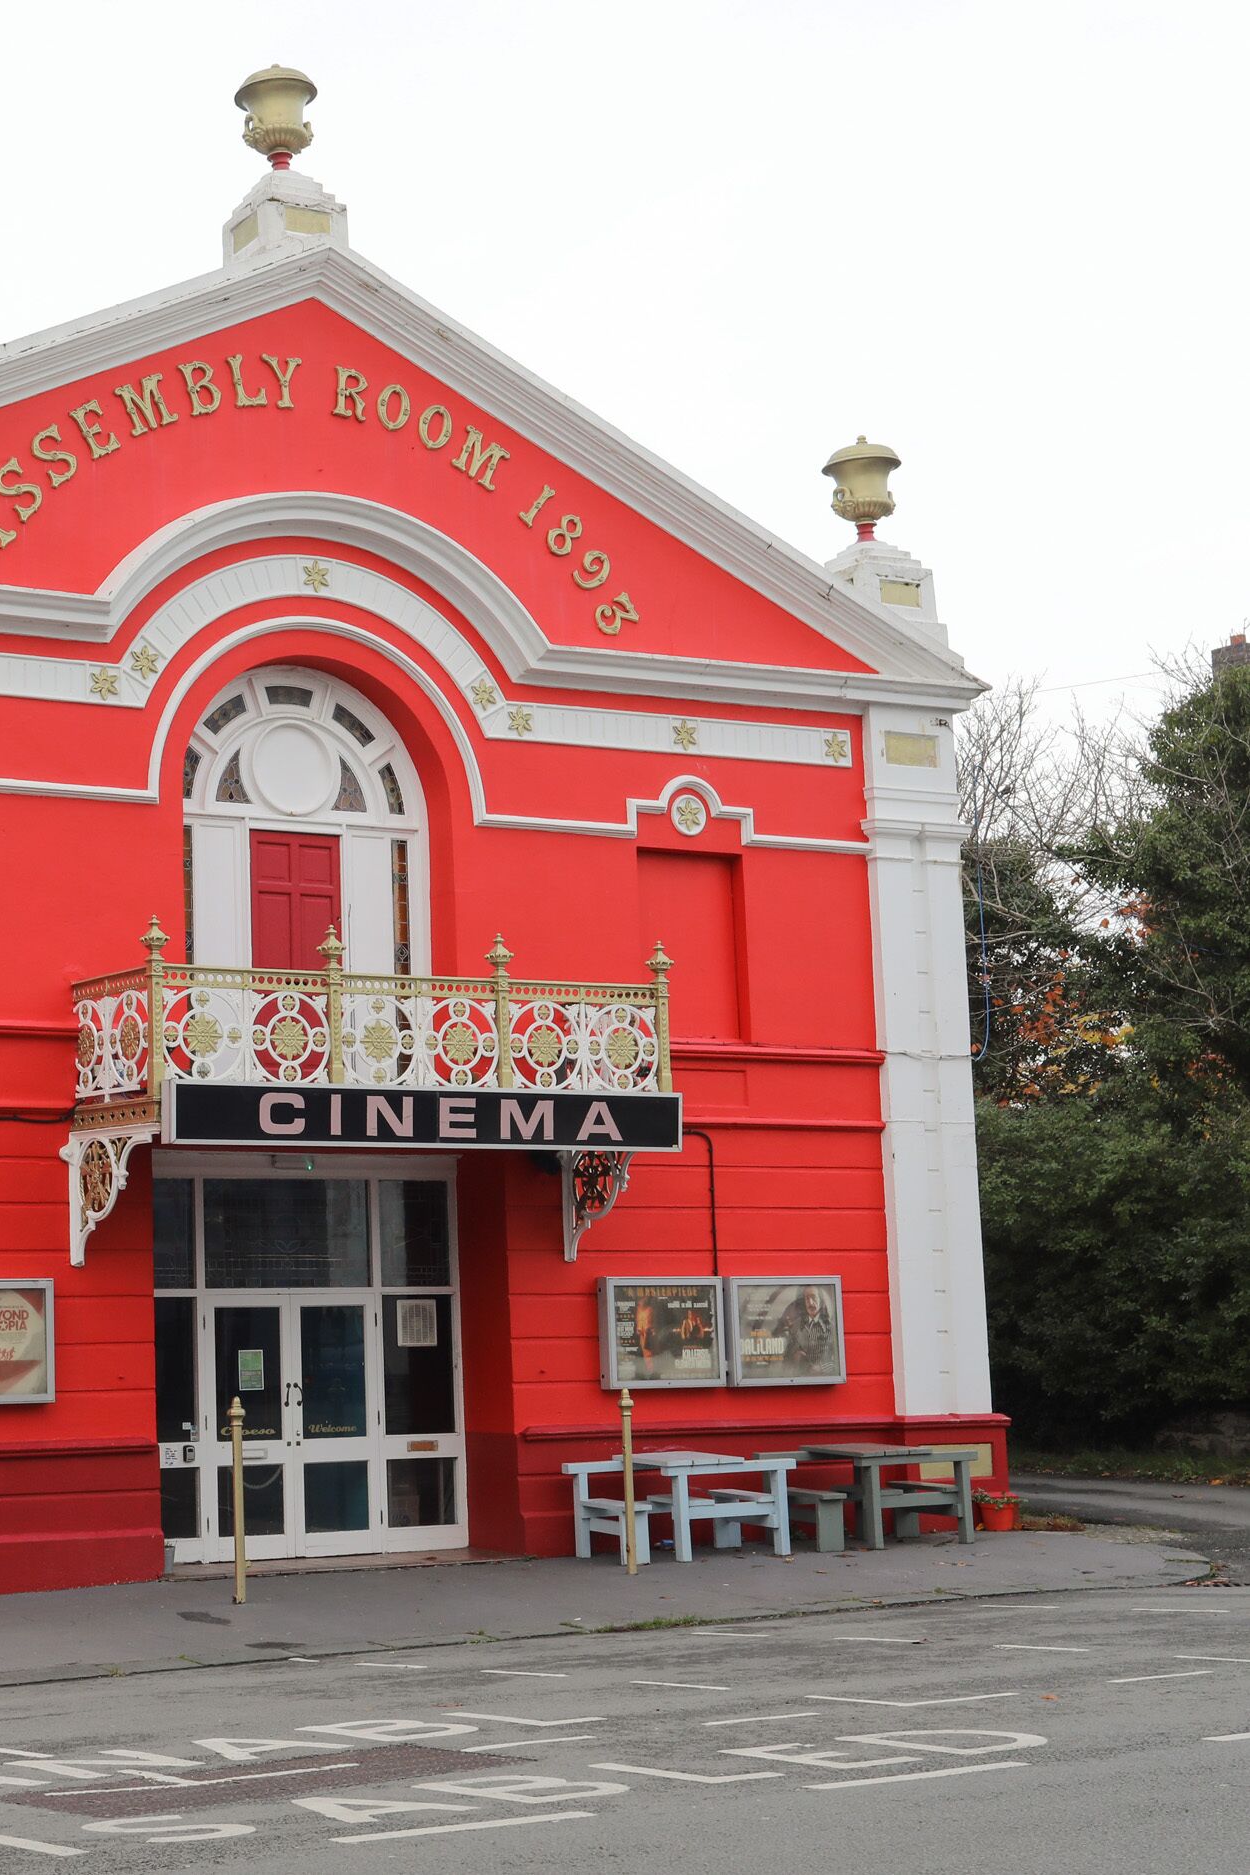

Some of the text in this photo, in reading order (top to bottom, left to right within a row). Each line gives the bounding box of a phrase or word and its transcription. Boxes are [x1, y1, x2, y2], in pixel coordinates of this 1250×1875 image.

[332, 364, 510, 491] ROOM
[518, 484, 640, 635] 1893
[258, 1092, 624, 1142] CINEMA
[220, 1423, 357, 1436] Coeso Welcome
